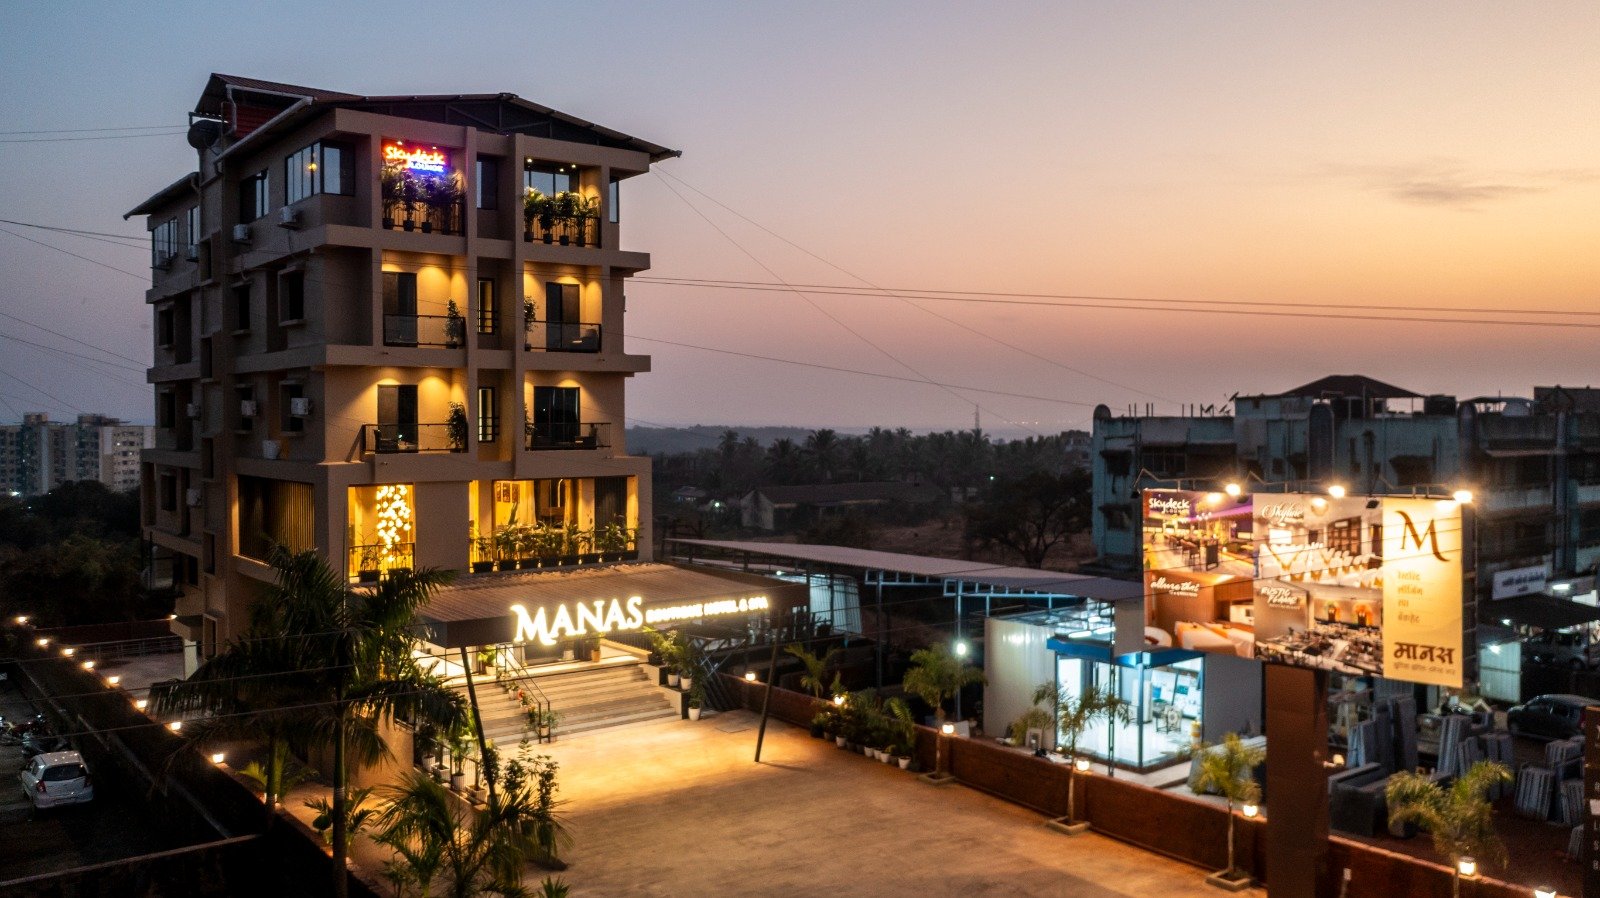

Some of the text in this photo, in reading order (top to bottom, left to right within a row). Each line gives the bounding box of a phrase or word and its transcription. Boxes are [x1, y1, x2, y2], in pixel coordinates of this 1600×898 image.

[1148, 498, 1190, 513] Skydeck
[1394, 510, 1450, 562] M
[510, 596, 644, 646] MANAS
[1393, 642, 1455, 665] मानस
